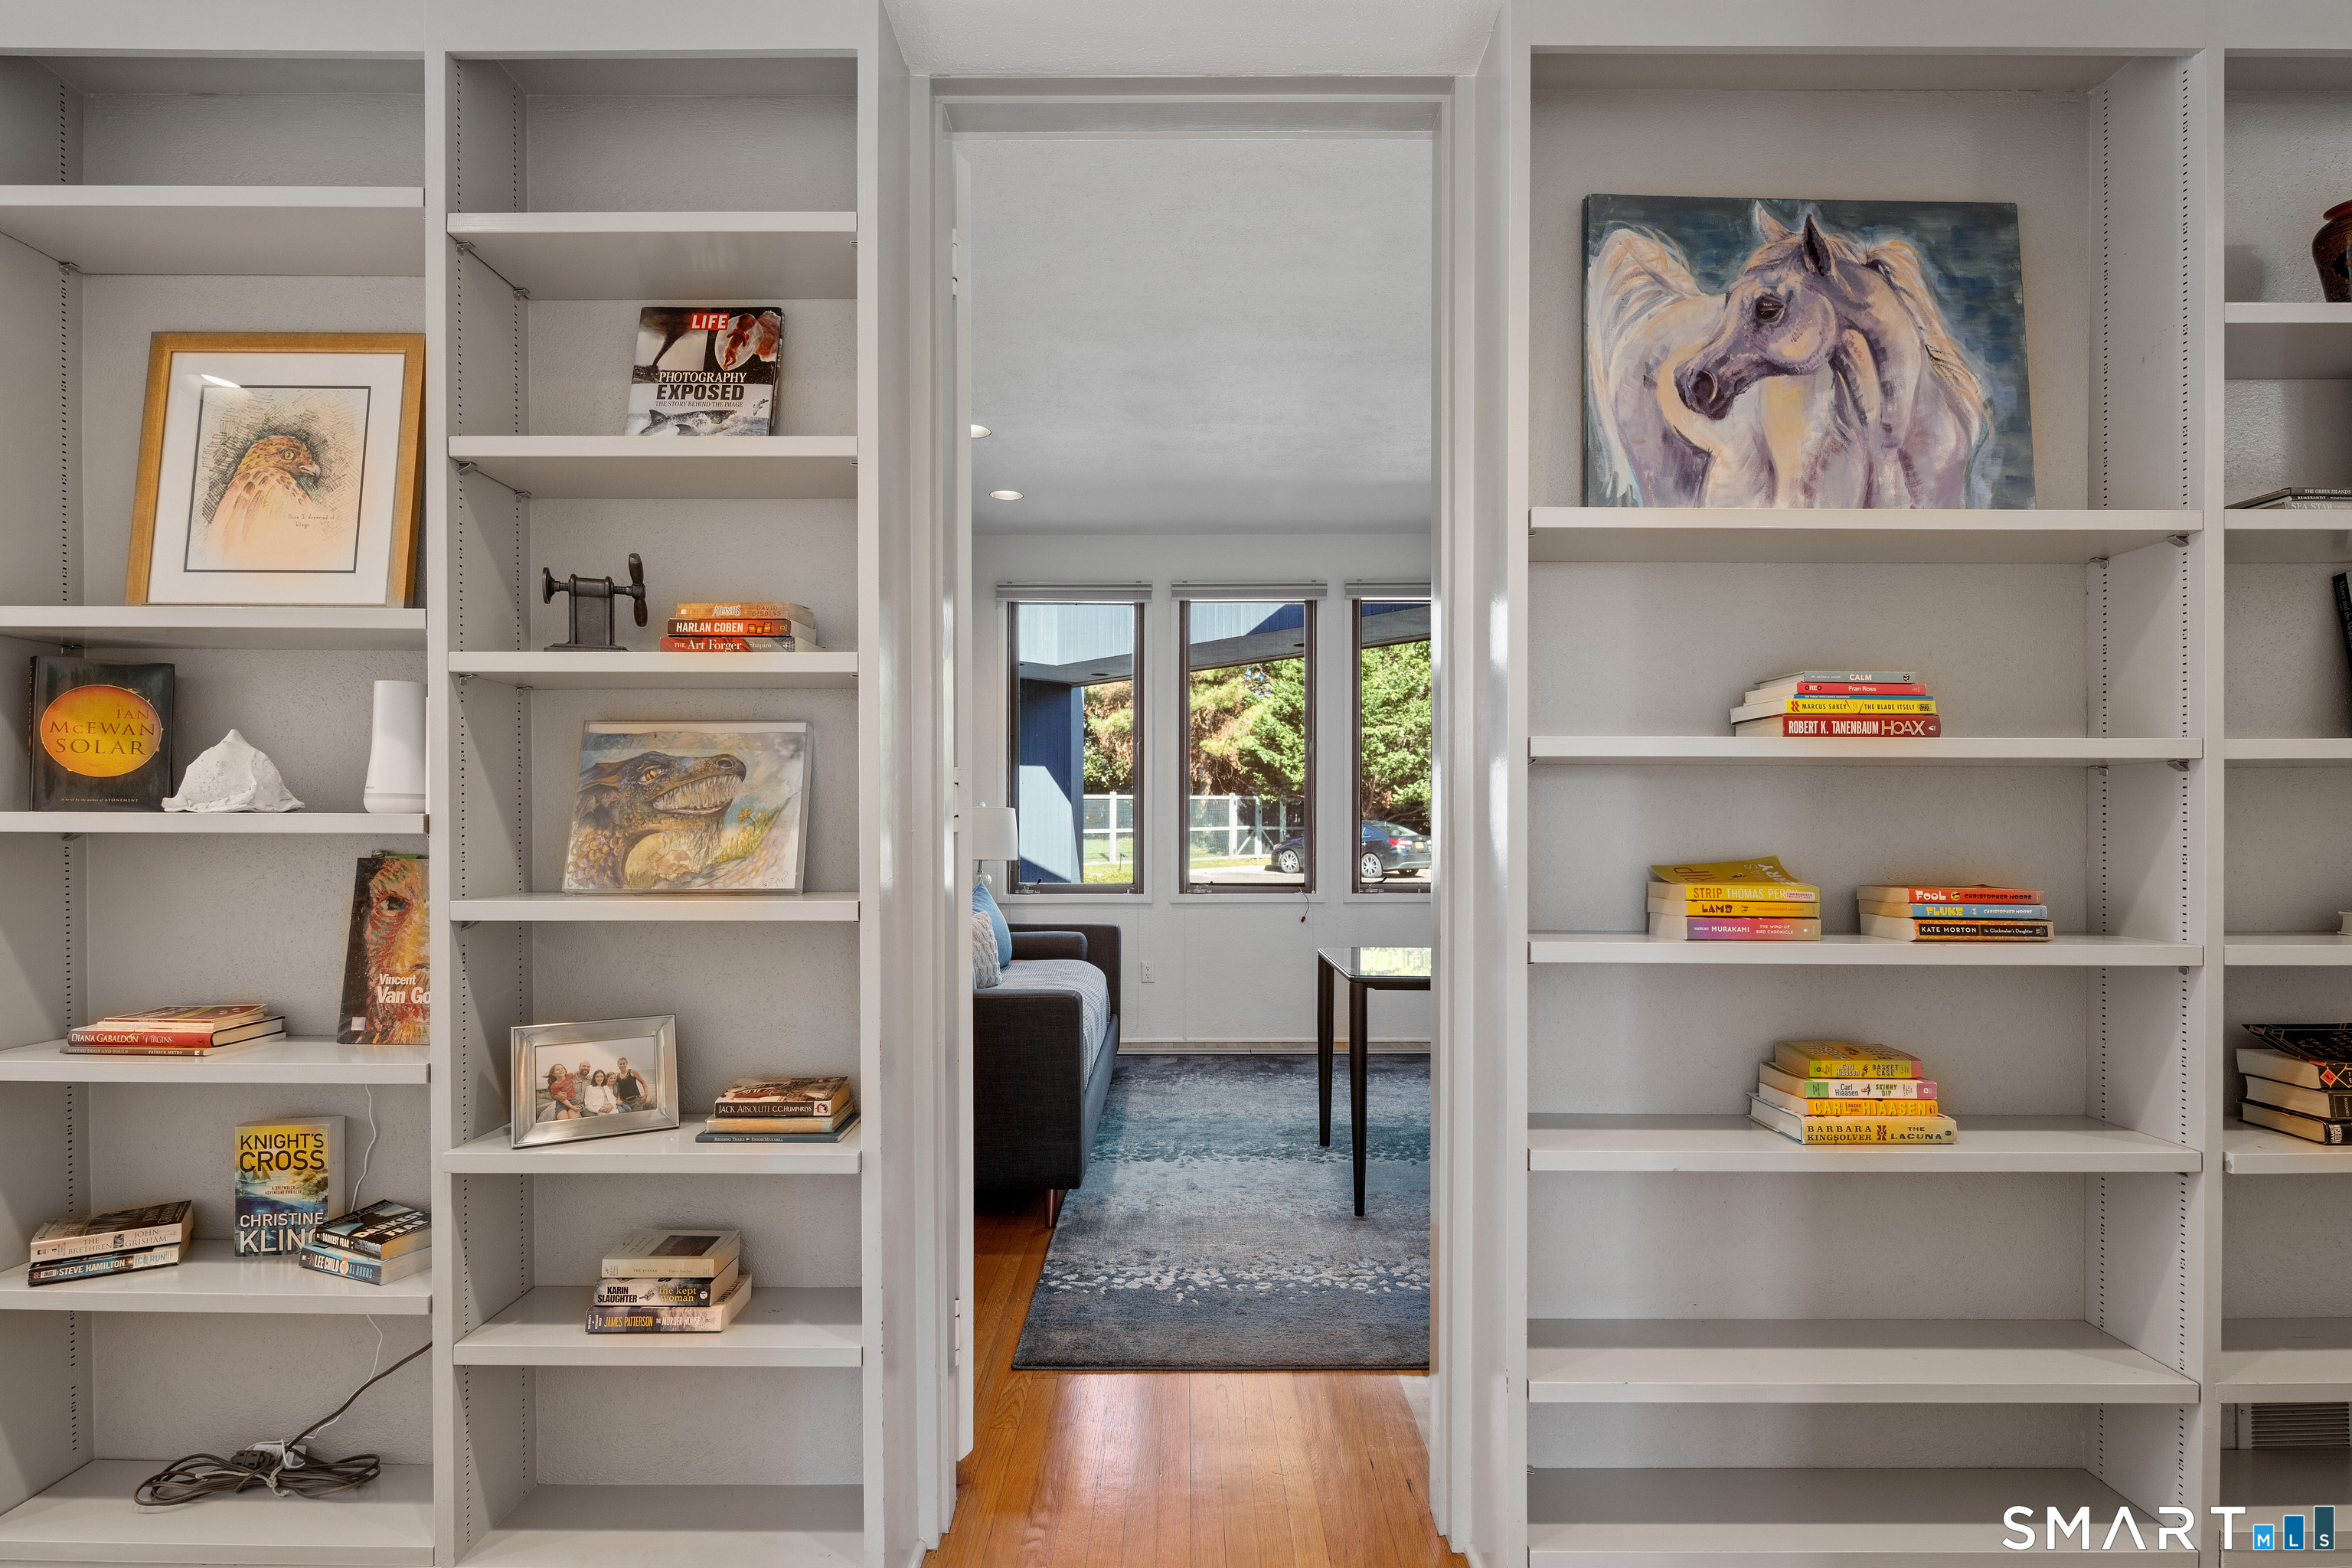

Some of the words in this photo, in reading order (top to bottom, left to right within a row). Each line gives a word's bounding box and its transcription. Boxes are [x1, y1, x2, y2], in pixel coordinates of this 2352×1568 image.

[691, 315, 727, 329] LIFE
[658, 372, 747, 383] PHOTOGRAPHY
[656, 384, 745, 400] EXPOSED
[712, 604, 741, 617] ATLANTIS
[676, 622, 711, 632] HARLAN
[714, 622, 743, 632] COBEN
[687, 639, 705, 650] Art
[708, 639, 742, 653] Forger
[117, 709, 149, 719] IAN
[50, 720, 155, 736] McEWAN
[1788, 720, 1818, 734] ROBERT
[1820, 720, 1829, 734] K.
[1831, 720, 1879, 734] TANENBAUM
[1880, 720, 1926, 736] HOAX
[55, 738, 146, 756] SOLAR
[1694, 887, 1722, 899] STRIP
[1726, 888, 1764, 899] THOMAS
[1915, 890, 1946, 900] FOOL
[1701, 904, 1733, 913] LAMB
[1926, 906, 1964, 916] FLUKE
[379, 973, 417, 985] Vincent
[377, 986, 406, 1004] Van
[71, 1033, 96, 1043] DIANA
[97, 1033, 139, 1043] GABALDON
[143, 1034, 174, 1045] VIRGINS
[718, 1105, 735, 1113] JACK
[737, 1105, 771, 1113] ABSOLUTE
[1813, 1100, 1852, 1115] CARL
[1862, 1101, 1927, 1116] HIAASEN
[2334, 1125, 2343, 1144] PATTERSON
[240, 1133, 325, 1150] KNIGHT'S
[240, 1149, 325, 1172] CROSS
[240, 1212, 324, 1227] CHRISTINE
[351, 1211, 425, 1238] DARKEST
[134, 1228, 159, 1239] JOHN
[383, 1220, 429, 1236] FEAR
[125, 1235, 167, 1247] GRISHAM
[322, 1233, 339, 1246] DARKEST
[339, 1237, 350, 1248] FEAR
[68, 1243, 113, 1255] BRETHREN
[58, 1266, 84, 1276] STEVE
[85, 1259, 126, 1272] HAMILTON
[135, 1255, 149, 1264] ICE
[149, 1253, 166, 1262] RUN
[314, 1254, 325, 1269] LEE
[325, 1258, 340, 1272] CHILD
[349, 1265, 355, 1274] 61
[355, 1266, 373, 1279] HOURS
[607, 1286, 629, 1295] KARIN
[658, 1286, 674, 1295] the
[676, 1286, 697, 1297] kept
[597, 1294, 638, 1303] SLAUGHTER
[603, 1316, 623, 1328] JAMES
[624, 1316, 653, 1327] PATTERSON
[662, 1316, 683, 1326] MURDER
[684, 1316, 701, 1325] HOUSE
